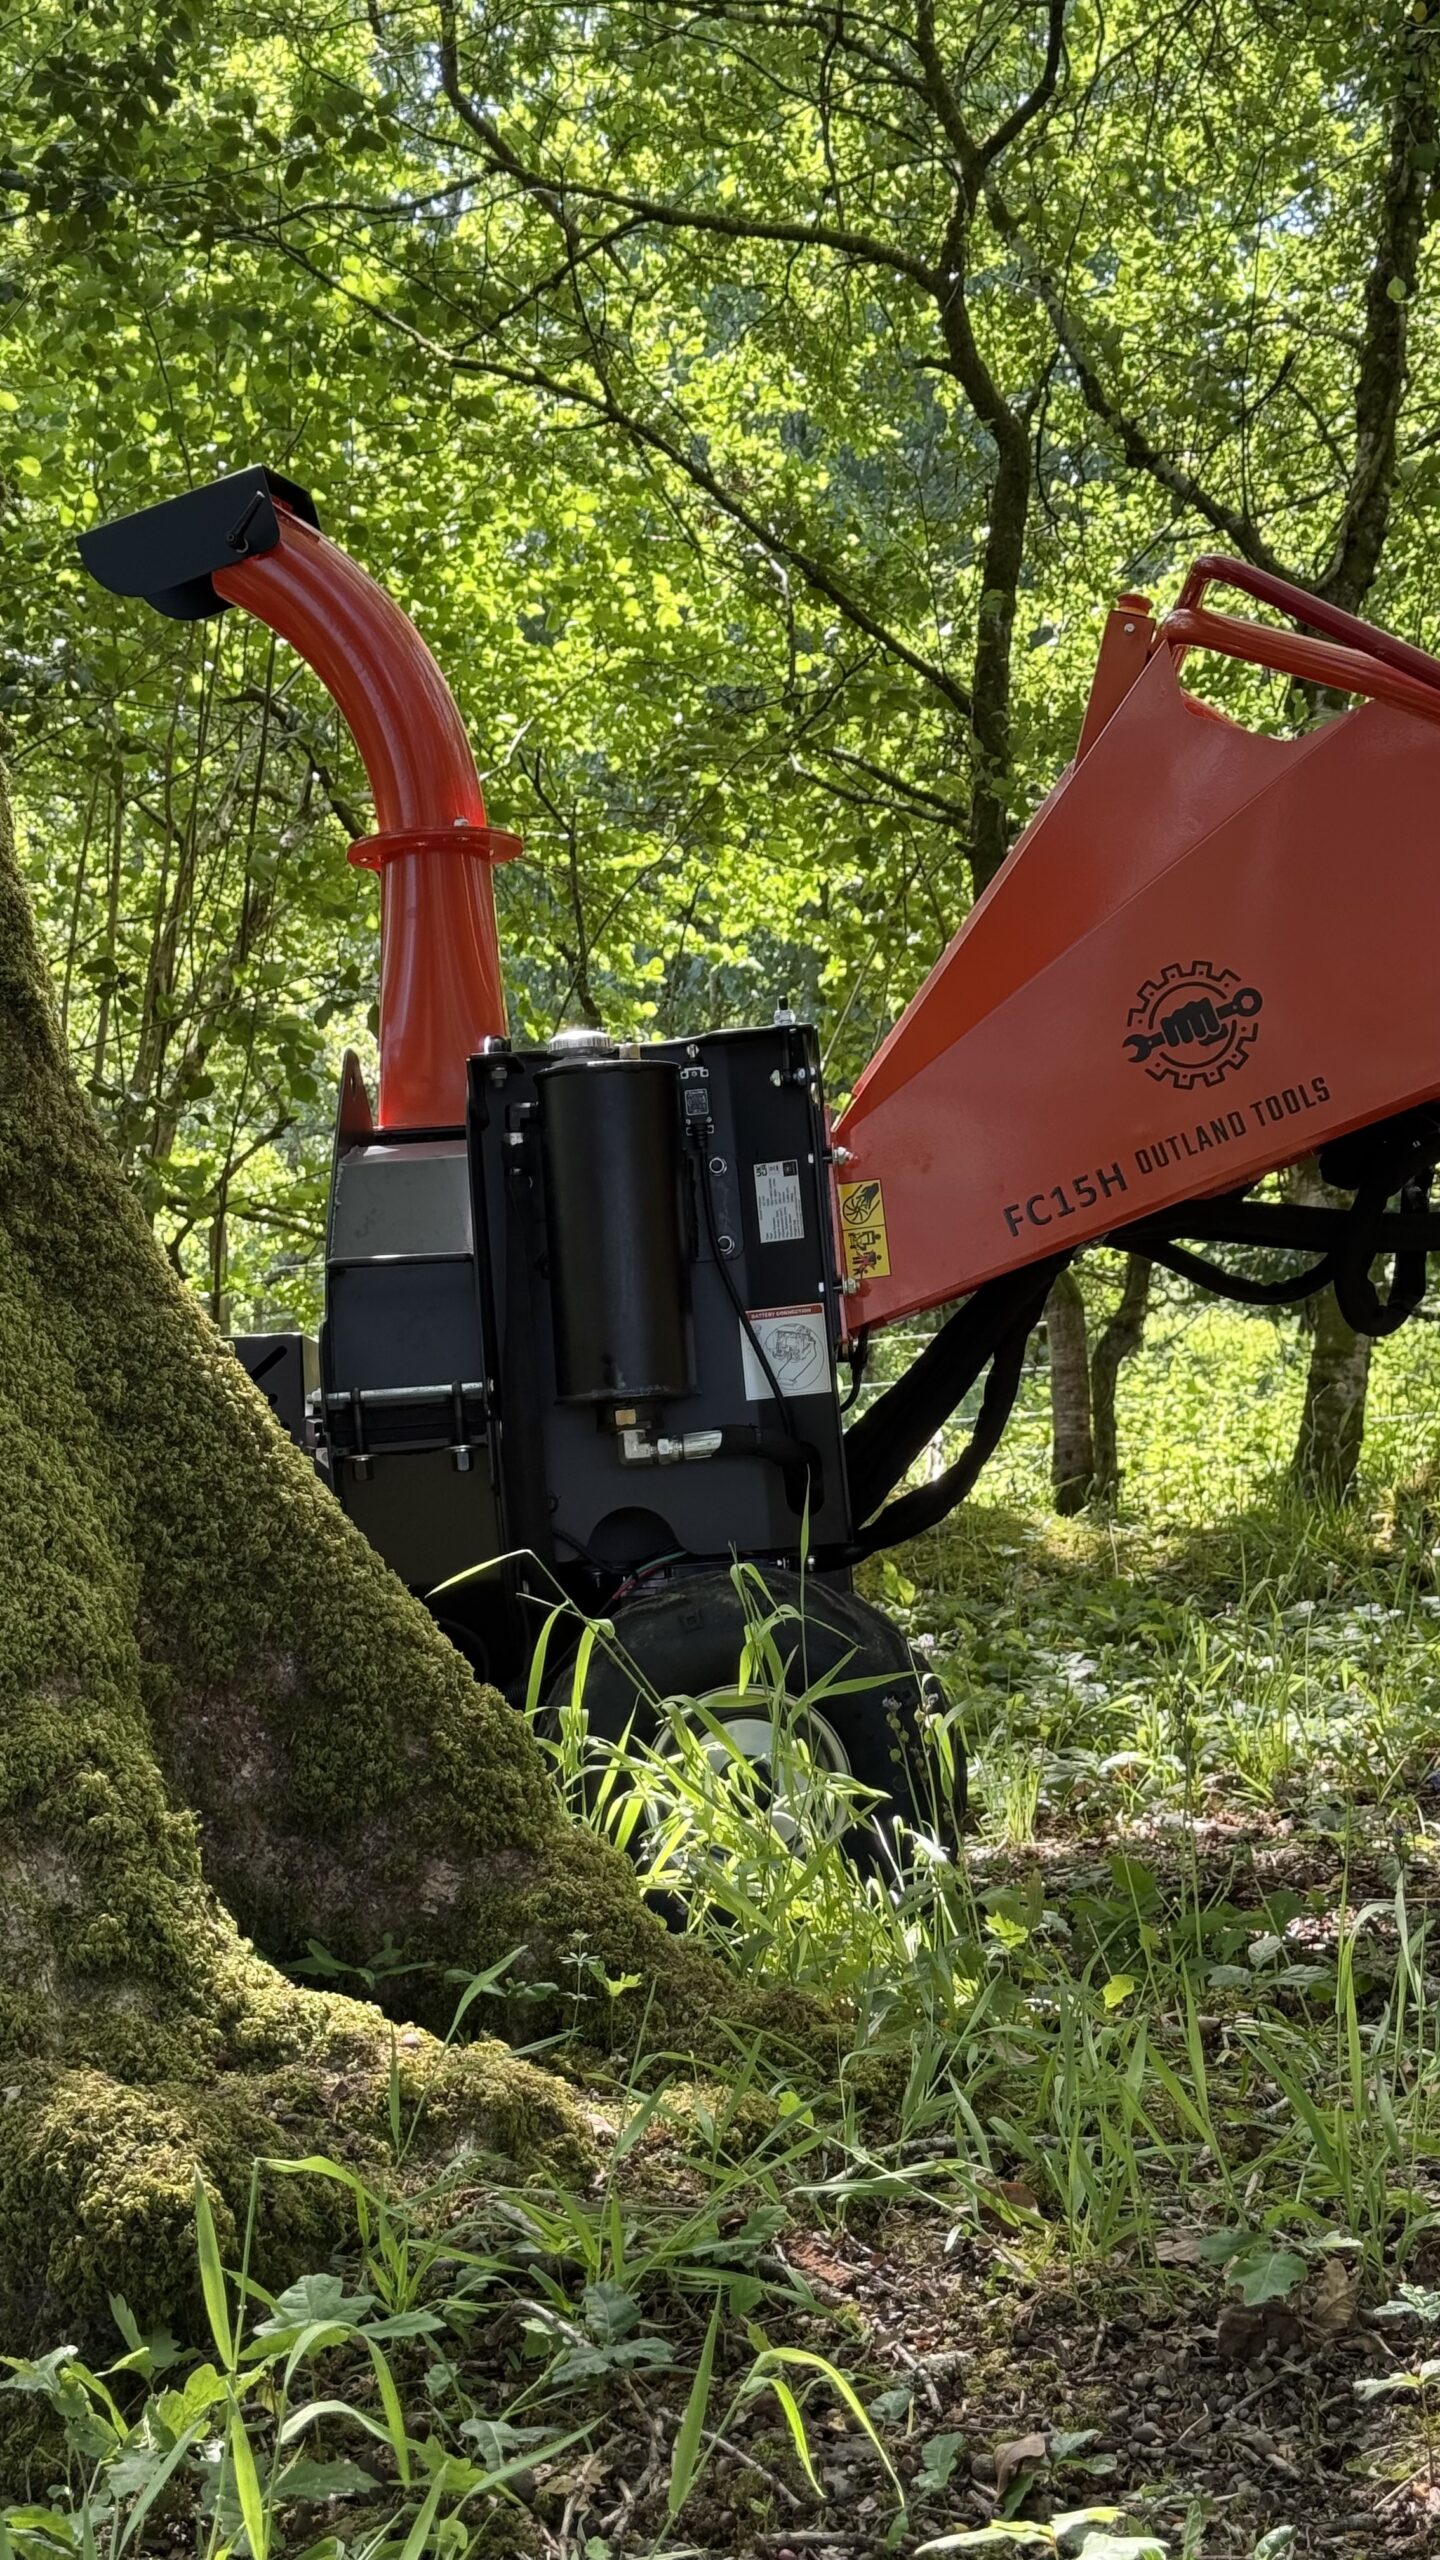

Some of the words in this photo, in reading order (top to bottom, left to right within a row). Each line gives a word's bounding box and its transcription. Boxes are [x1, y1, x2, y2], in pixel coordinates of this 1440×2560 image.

[1003, 1162, 1128, 1237] FC15H
[1134, 1111, 1247, 1174] OUTLAND
[1249, 1076, 1331, 1127] TOOLS
[751, 1311, 775, 1319] BATTERY
